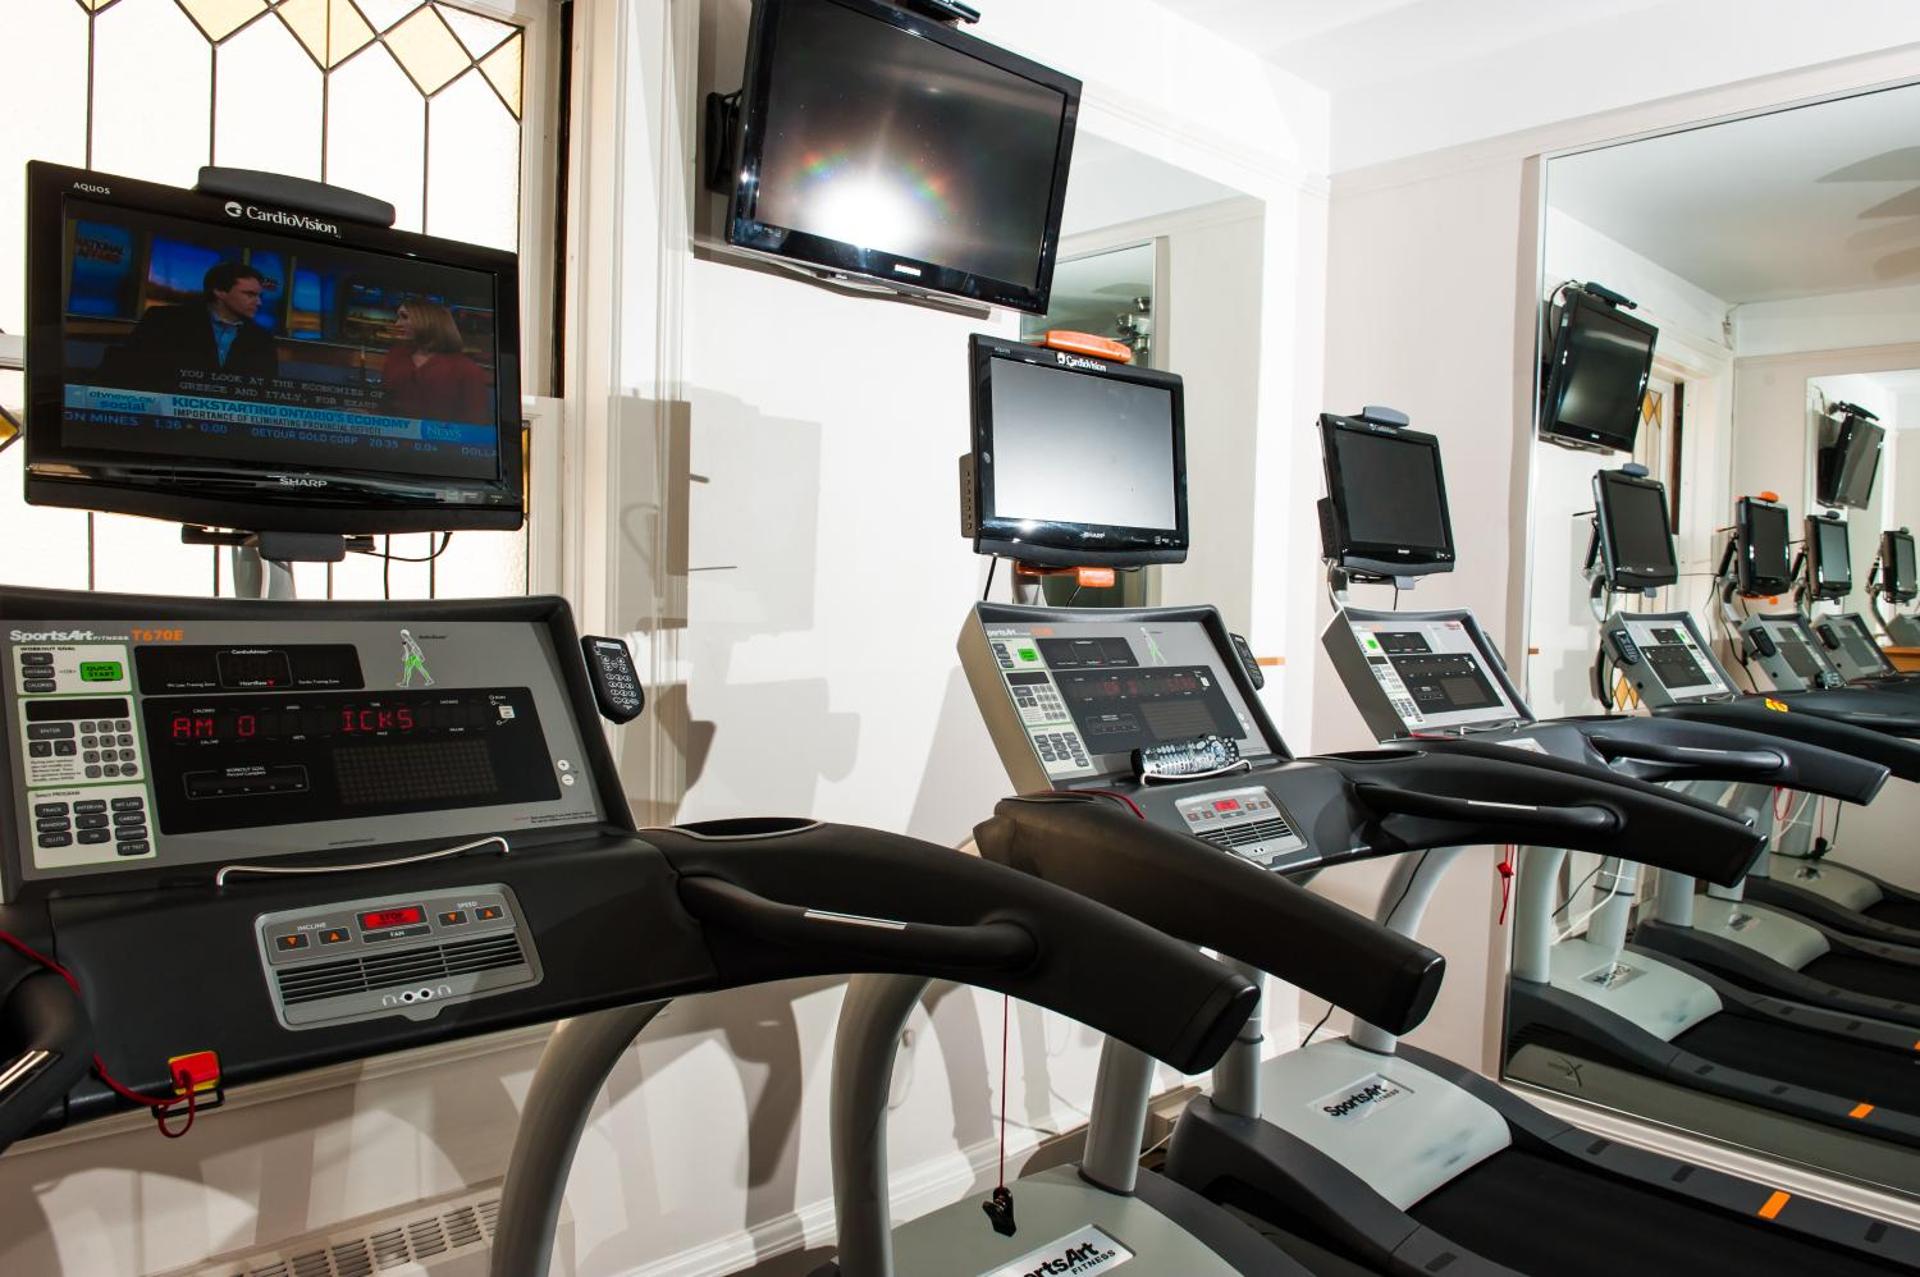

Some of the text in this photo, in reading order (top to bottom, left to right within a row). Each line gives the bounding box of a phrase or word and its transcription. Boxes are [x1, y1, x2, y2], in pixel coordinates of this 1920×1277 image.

[73, 182, 111, 195] AQUOS
[246, 206, 338, 235] CardioVision
[211, 372, 242, 383] LOOK
[249, 377, 264, 386] AT
[272, 379, 294, 389] THE
[370, 390, 384, 399] OF
[235, 388, 258, 397] AND
[172, 397, 410, 429] KICKSTARTING ONTARIO'S ECONOMY
[173, 407, 235, 422] IMPORTANCE
[237, 414, 249, 423] OF
[279, 477, 328, 488] SHARP
[9, 630, 93, 643] SportsArt
[131, 629, 184, 641] T670E
[390, 930, 405, 938] FAN
[1323, 1084, 1387, 1117] SportsArt
[1024, 1242, 1100, 1277] rtsArt
[1072, 1249, 1116, 1275] FITNESS
